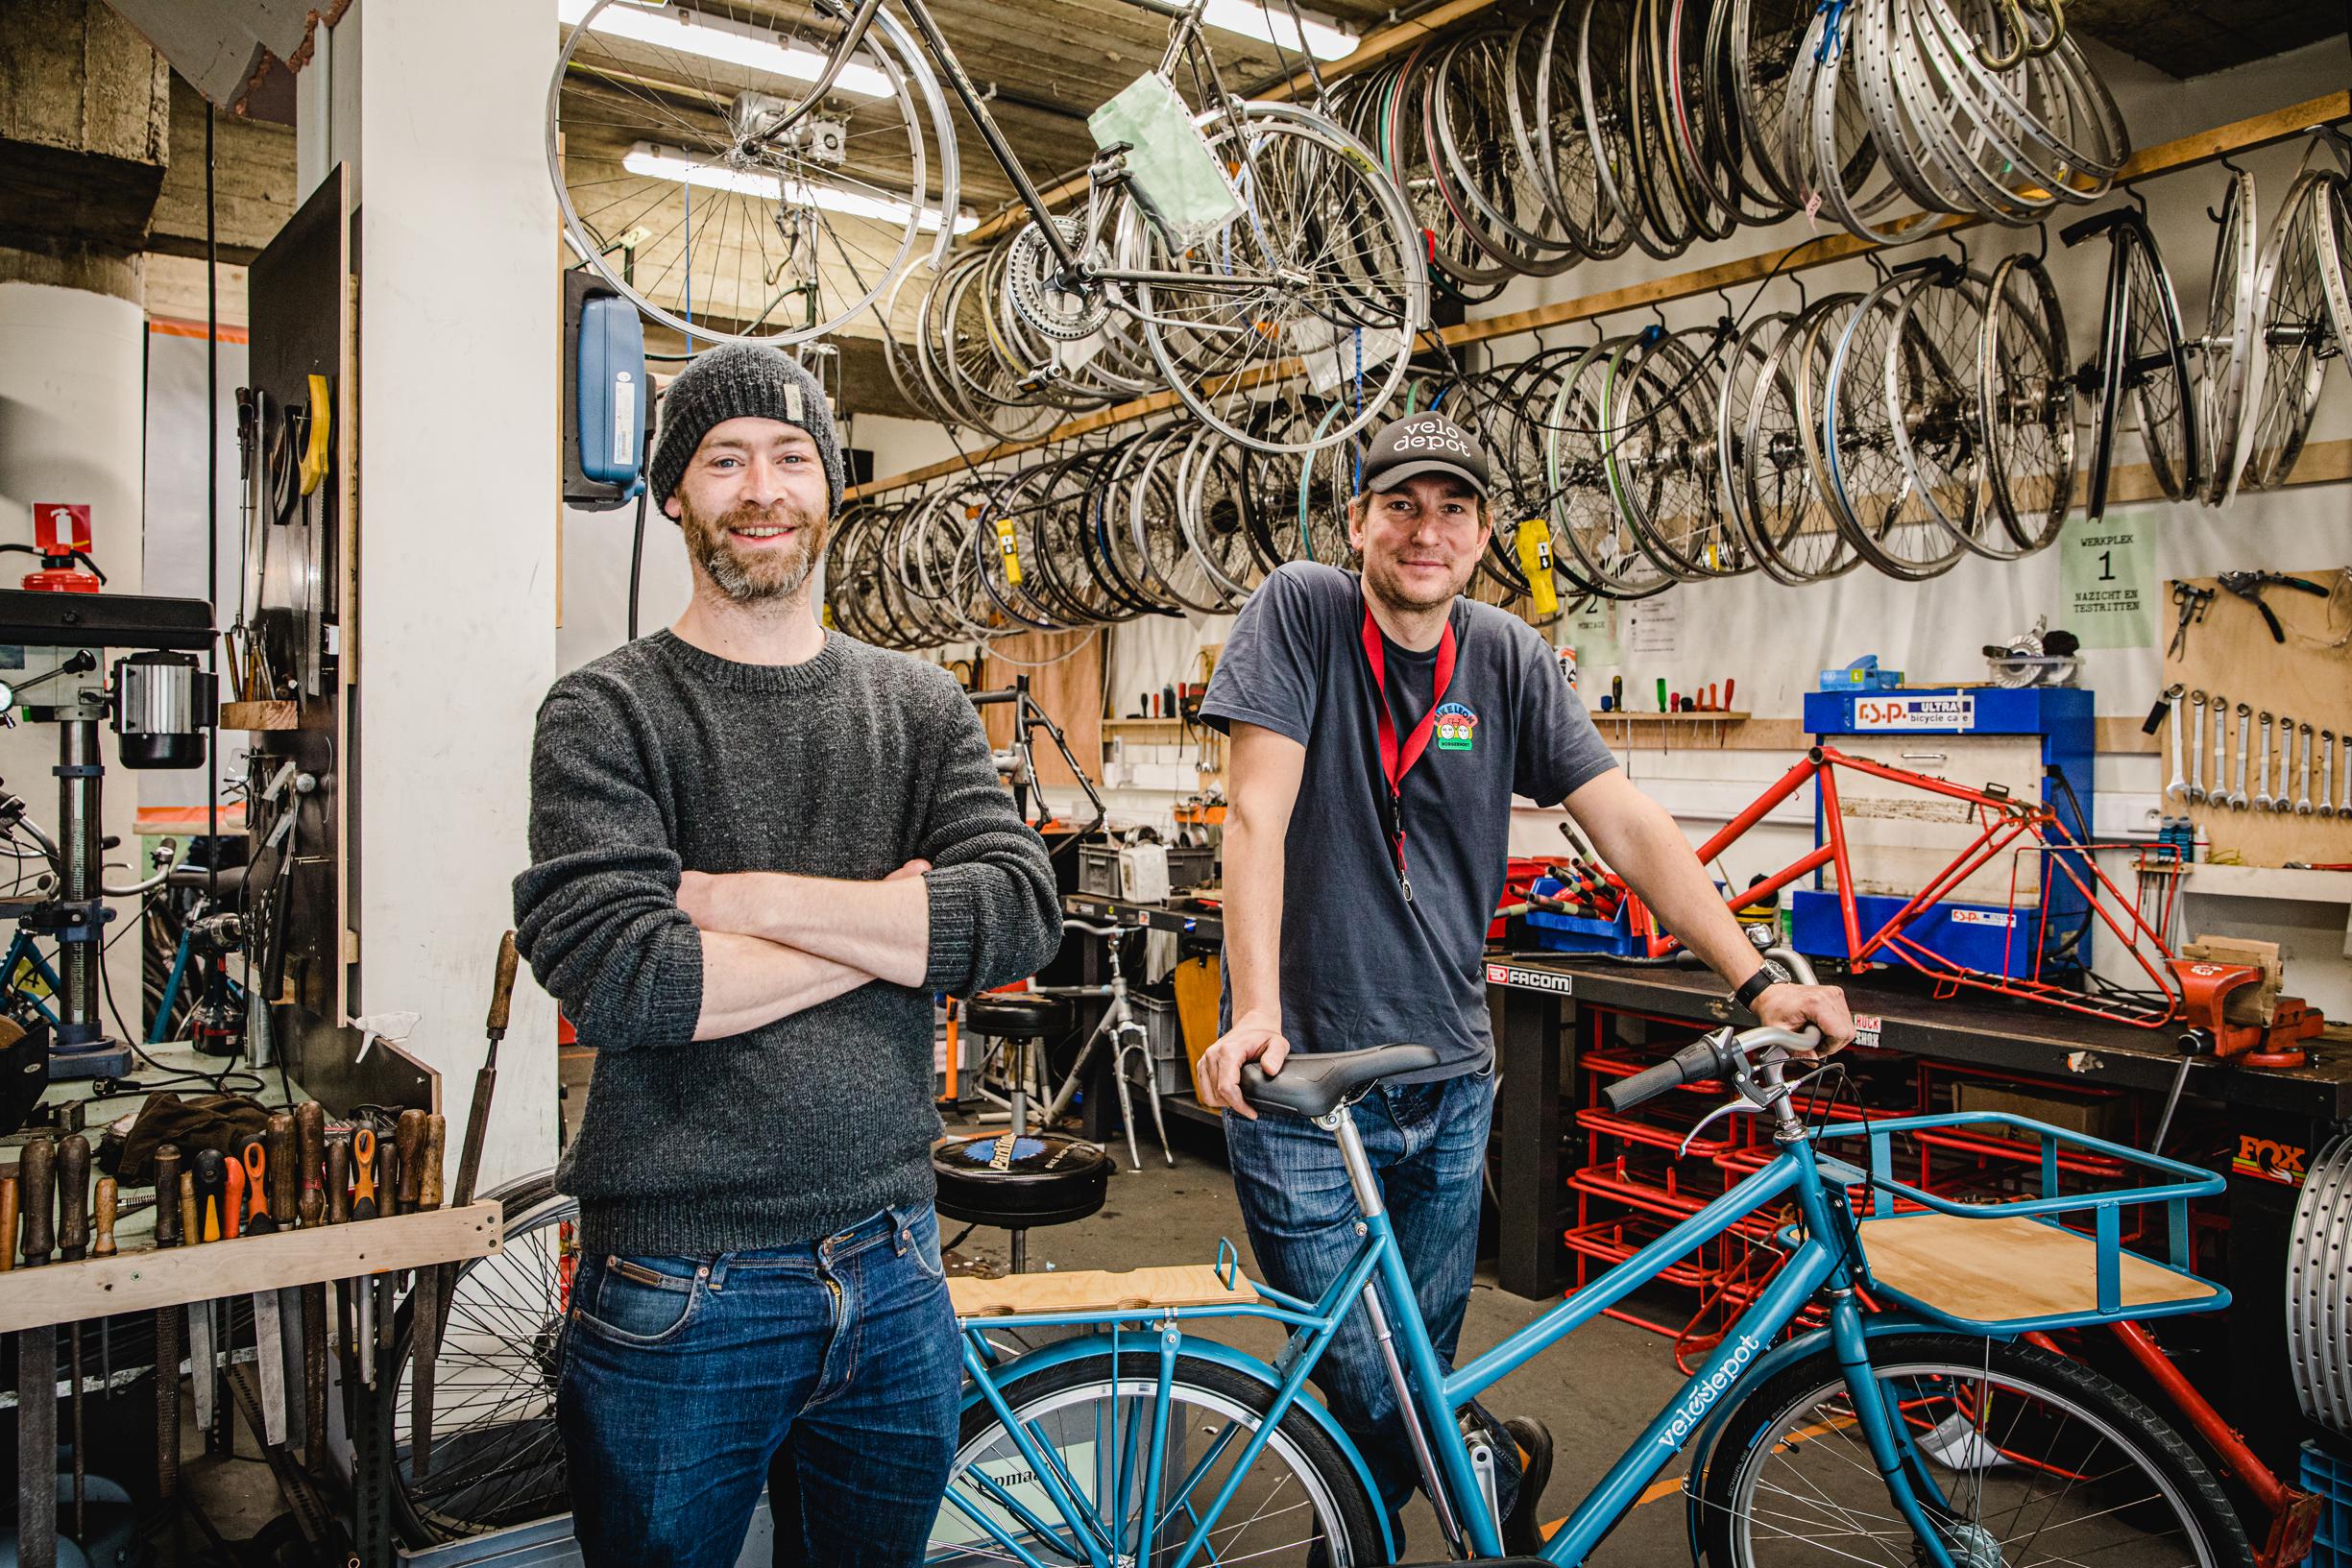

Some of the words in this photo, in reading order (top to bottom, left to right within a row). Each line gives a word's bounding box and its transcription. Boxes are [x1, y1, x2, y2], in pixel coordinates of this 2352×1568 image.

[1403, 419, 1459, 439] velo
[1393, 435, 1471, 457] depot
[2080, 534, 2134, 547] WERKPLEK
[2097, 550, 2116, 581] 1
[2074, 590, 2122, 601] NAZICHT
[2124, 590, 2138, 600] EN
[2073, 601, 2140, 614] TESTRITTEN
[1921, 702, 1960, 713] ULTRA
[1910, 713, 1944, 724] bicycle
[1947, 714, 1969, 723] cae
[1509, 970, 1569, 992] FACOM
[2238, 1134, 2306, 1173] FOX
